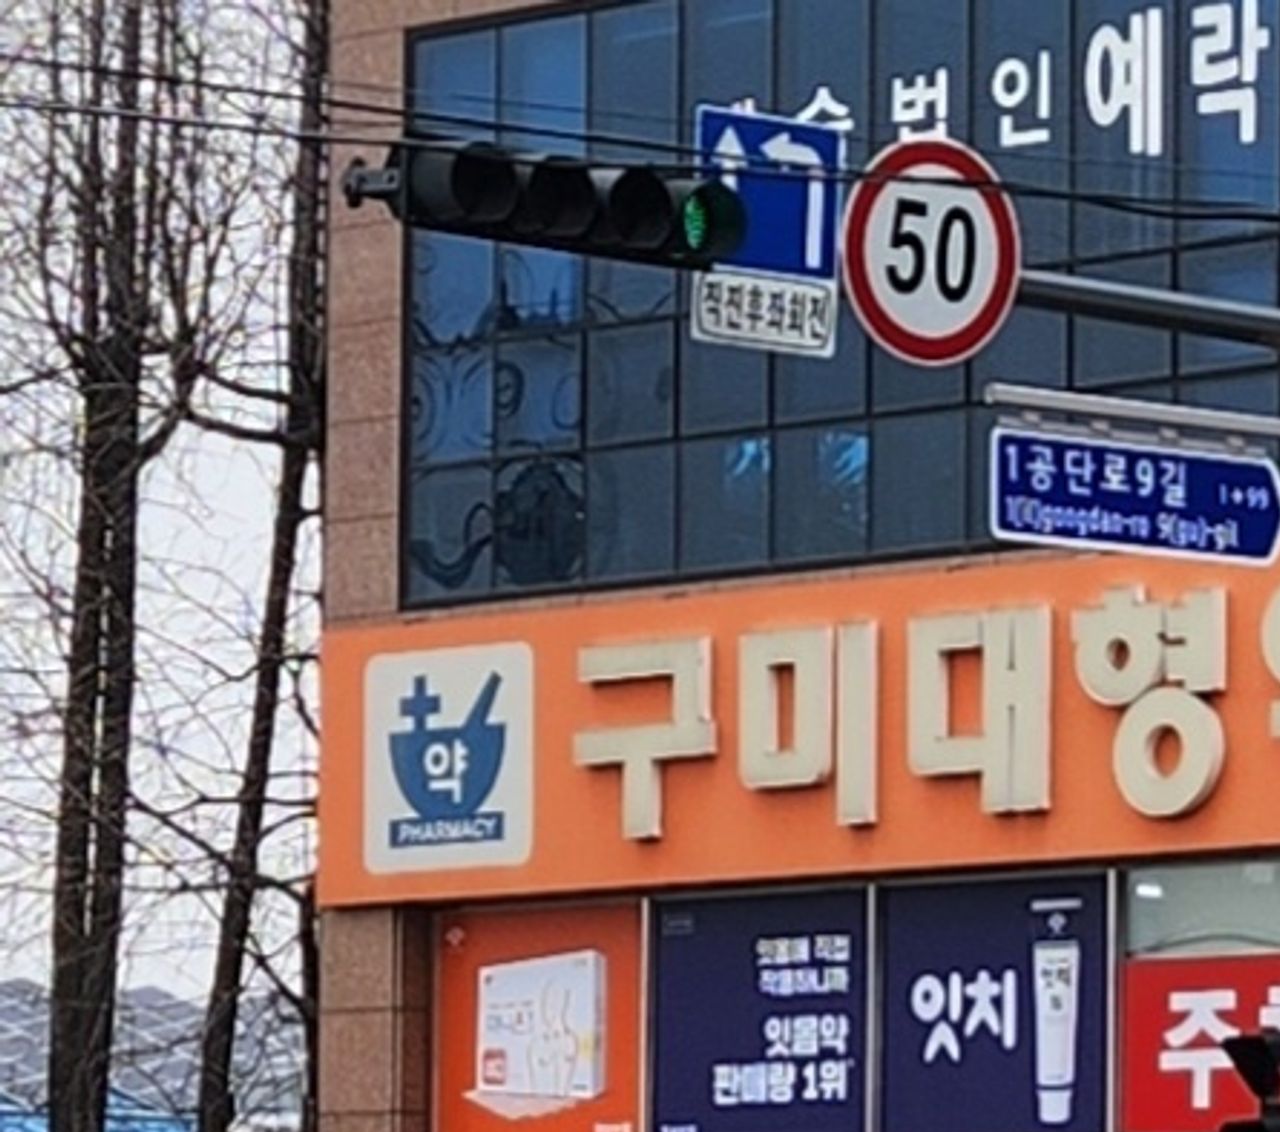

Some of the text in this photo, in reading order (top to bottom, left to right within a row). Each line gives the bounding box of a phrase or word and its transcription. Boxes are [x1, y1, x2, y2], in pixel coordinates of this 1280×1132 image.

[1085, 1, 1270, 155] 예락
[886, 197, 977, 302] 50
[1006, 444, 1187, 508] 1공단로9길
[422, 741, 470, 803] 약
[398, 815, 500, 844] PHARMACY
[764, 1015, 849, 1058] 잇몸약
[910, 969, 1017, 1064] 잇치
